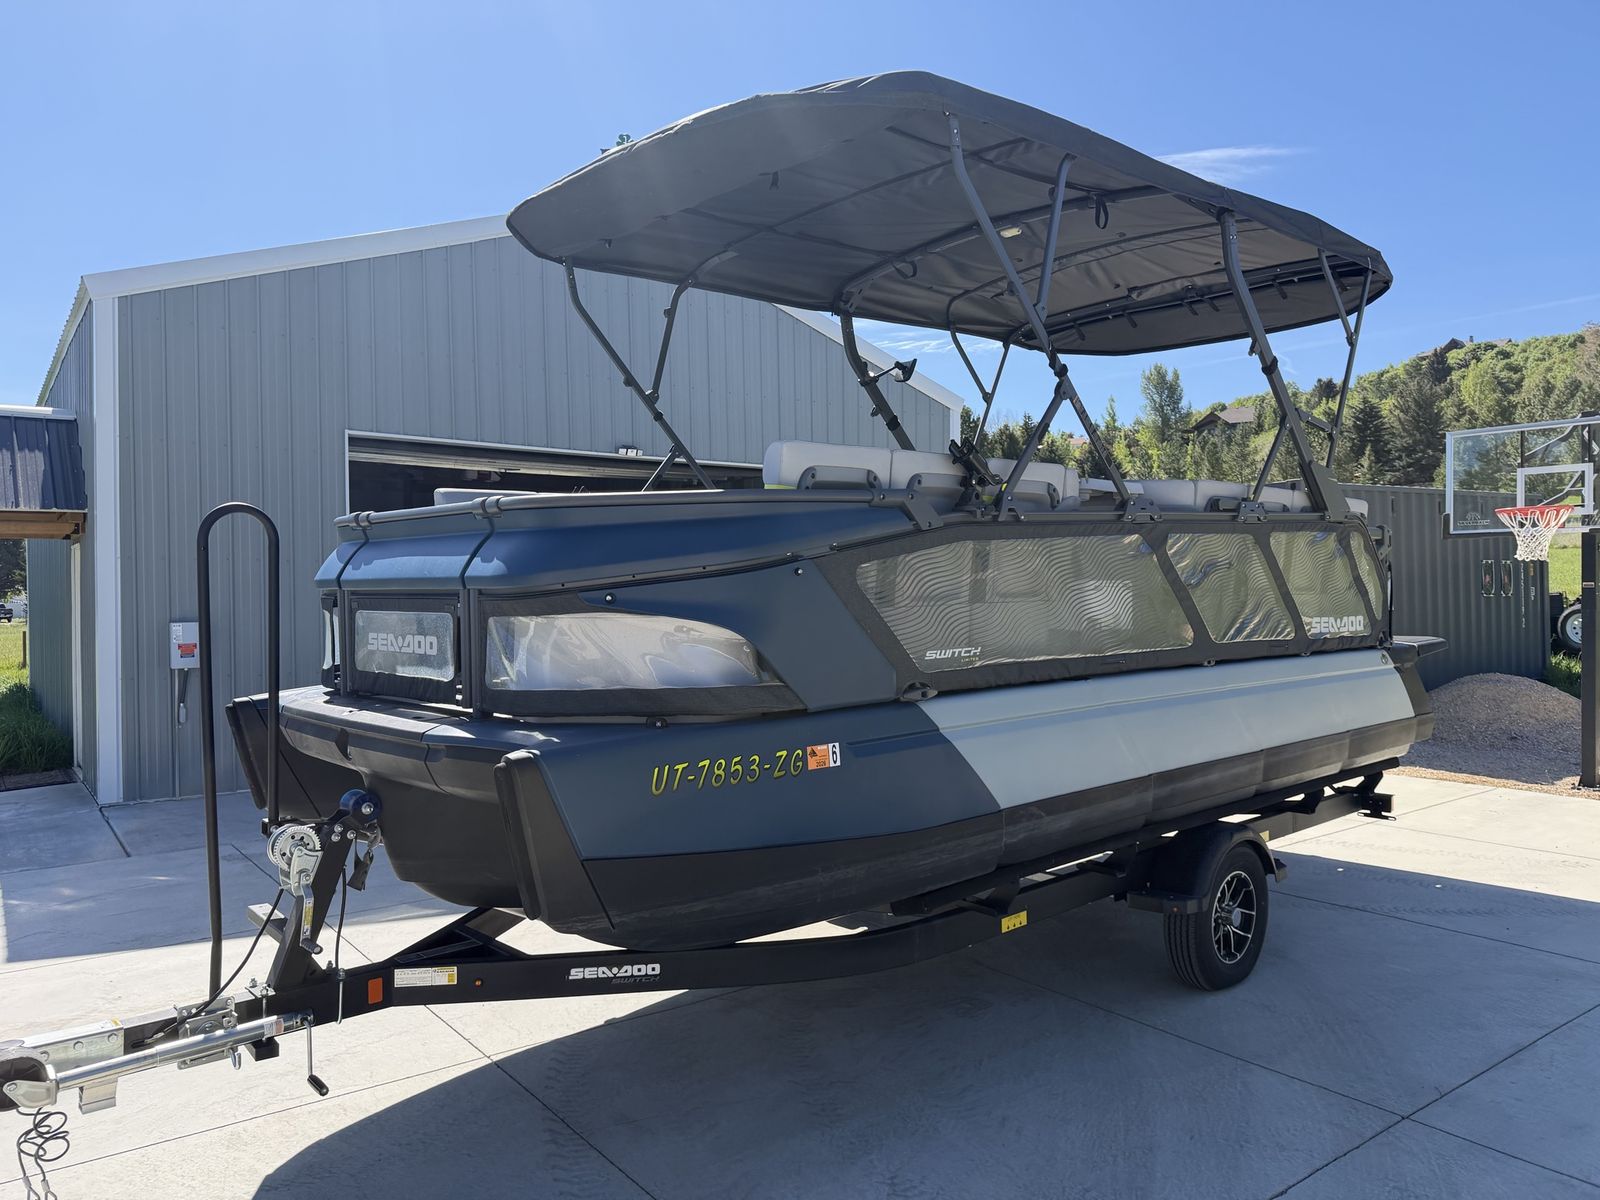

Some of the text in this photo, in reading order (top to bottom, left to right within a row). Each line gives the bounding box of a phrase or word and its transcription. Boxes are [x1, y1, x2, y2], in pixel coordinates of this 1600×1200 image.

[924, 646, 982, 660] SWITCH
[832, 744, 838, 765] 6
[651, 749, 803, 796] UT-7853-ZG
